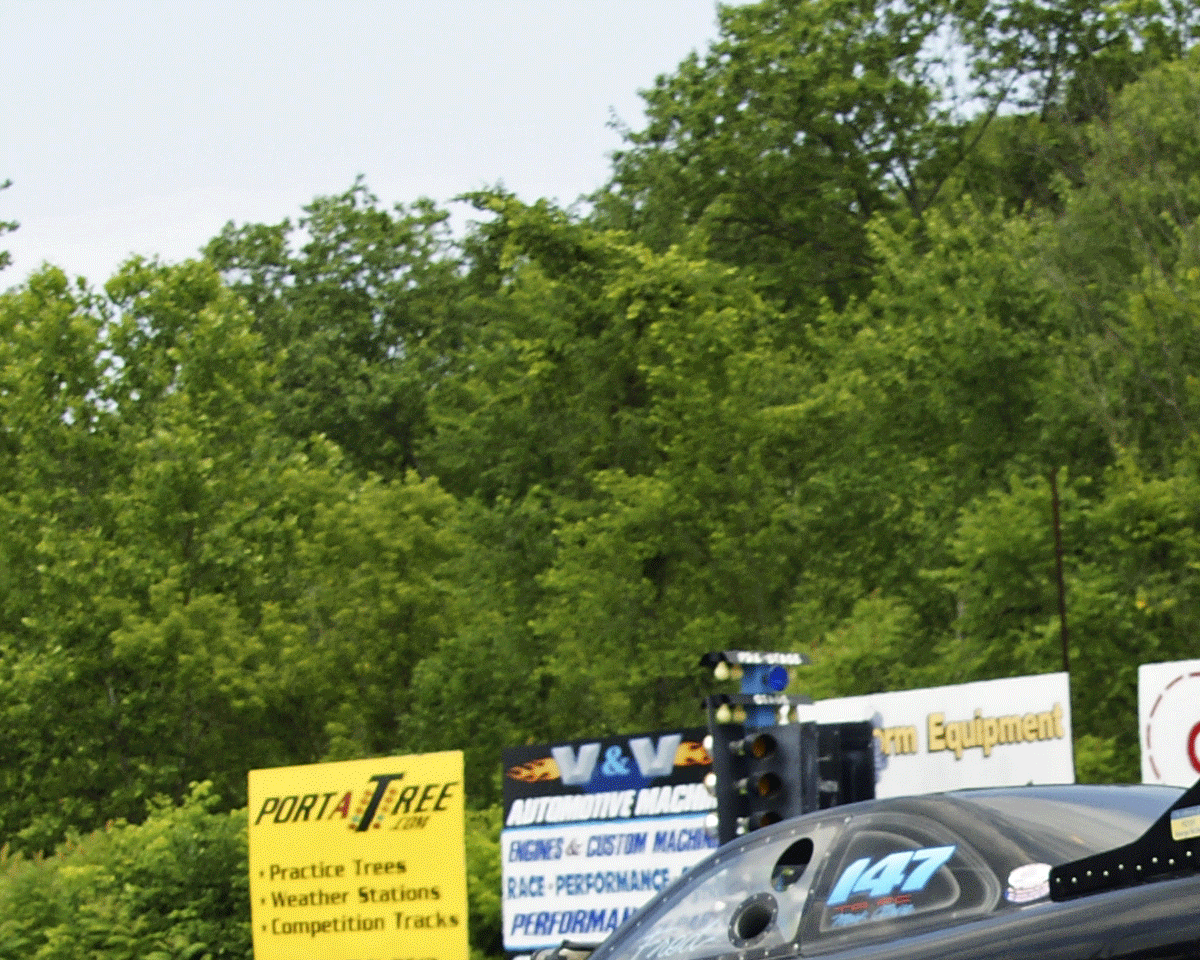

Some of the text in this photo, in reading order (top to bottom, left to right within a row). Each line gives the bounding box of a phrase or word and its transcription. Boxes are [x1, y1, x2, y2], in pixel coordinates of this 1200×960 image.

[927, 702, 1065, 760] Equipment
[551, 733, 682, 786] V & V
[506, 790, 637, 826] AUTOMOTIVE
[510, 837, 564, 863] ENGINES
[586, 832, 648, 857] CUSTOM
[270, 859, 407, 881] Practice Trees
[508, 868, 670, 898] RACE PERFORMANCE
[826, 845, 956, 905] 147
[271, 884, 441, 908] Weather Stations
[271, 911, 460, 938] Competition Tracks
